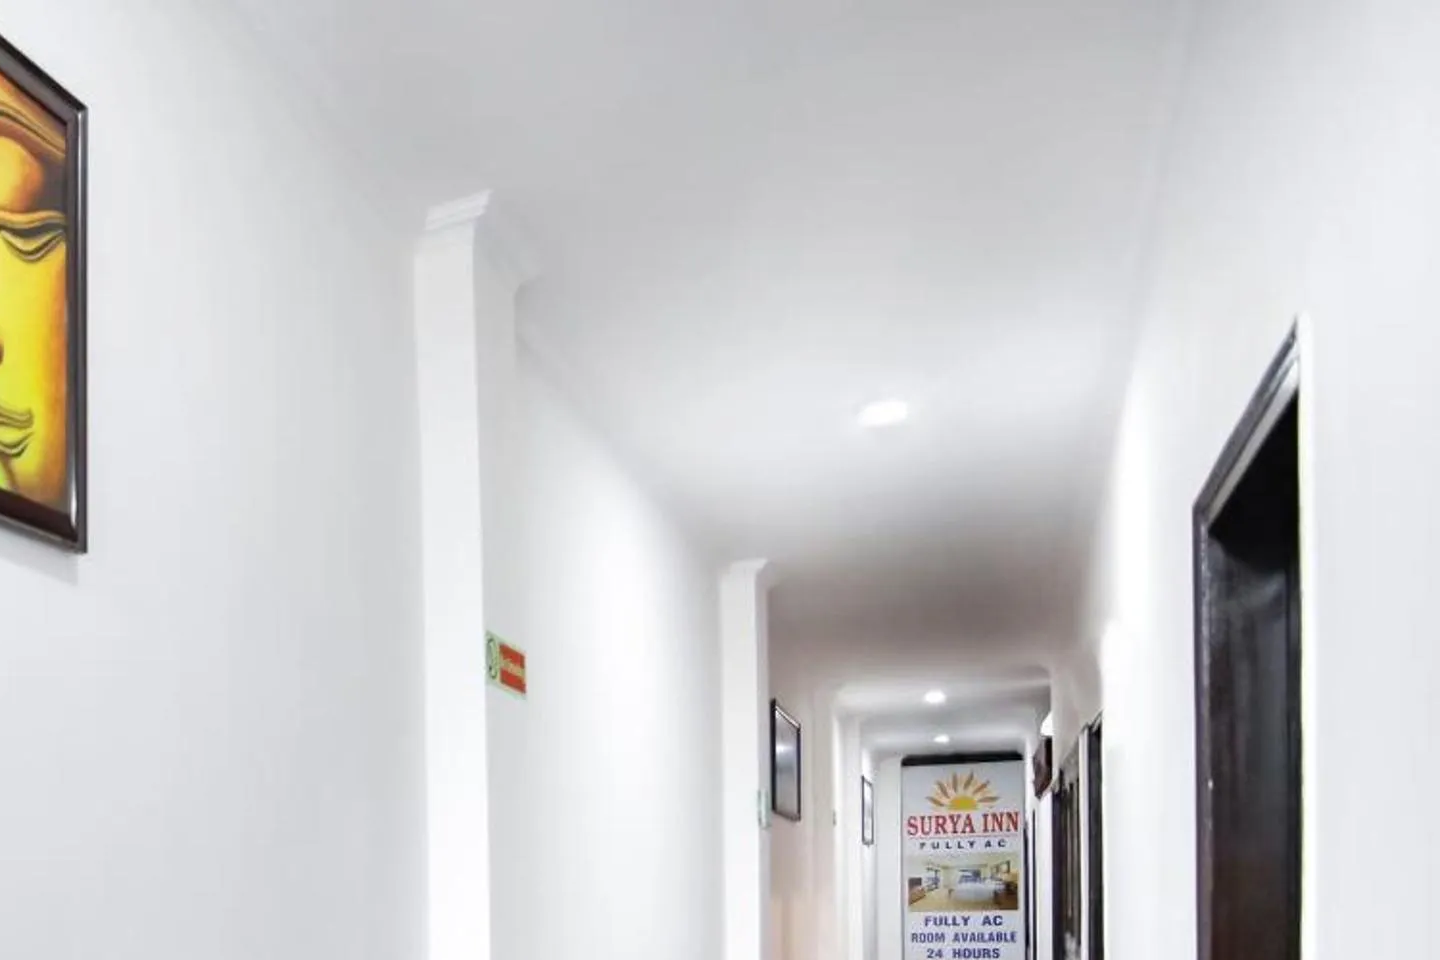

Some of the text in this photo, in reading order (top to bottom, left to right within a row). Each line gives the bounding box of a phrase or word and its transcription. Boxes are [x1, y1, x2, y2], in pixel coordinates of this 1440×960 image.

[907, 812, 1019, 835] SURYA INN
[984, 839, 1006, 848] AC
[925, 915, 1003, 927] FULLY AC
[911, 931, 1017, 943] ROOM AVAILABLE
[927, 948, 1000, 959] 24 HOURS
